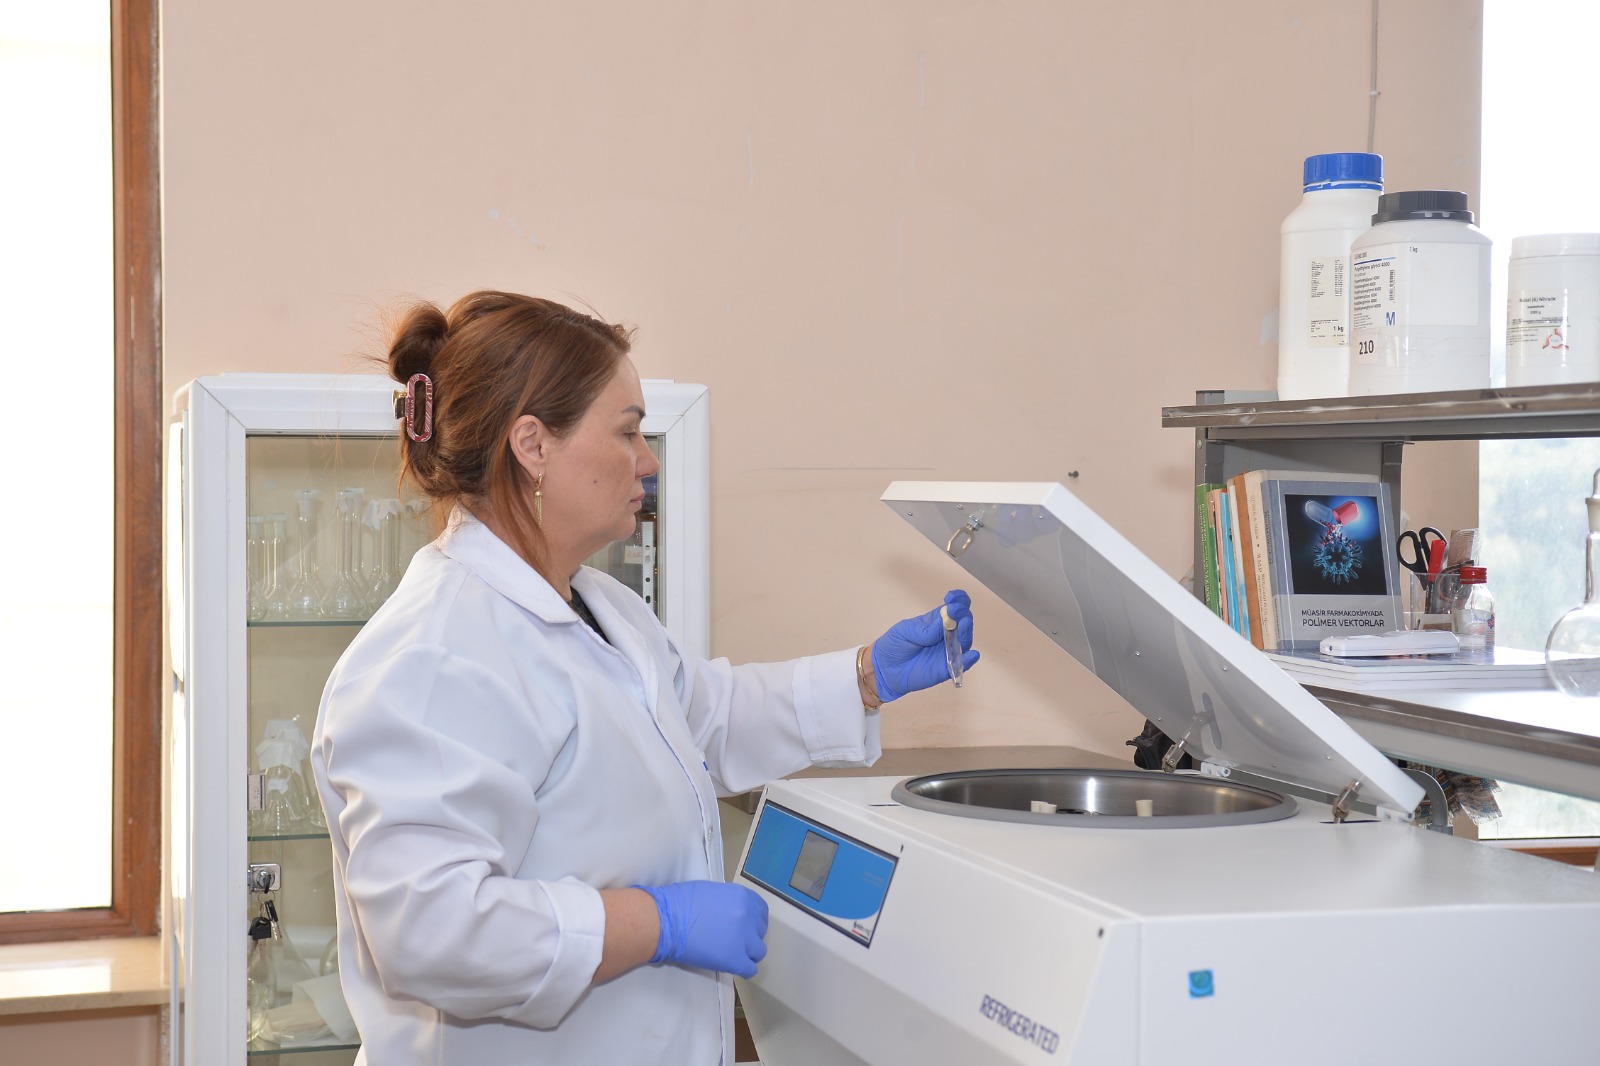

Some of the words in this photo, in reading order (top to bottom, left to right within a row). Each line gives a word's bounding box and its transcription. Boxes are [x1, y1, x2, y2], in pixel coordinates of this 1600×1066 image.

[1386, 312, 1396, 326] M
[1359, 340, 1374, 355] 210
[1301, 609, 1326, 617] MÜASİR
[1327, 609, 1384, 617] FARMAKOKİMYADA
[1302, 618, 1337, 627] POLİMER
[1338, 619, 1385, 627] VEKTORLAR
[980, 994, 1060, 1055] REFRIGERATED
